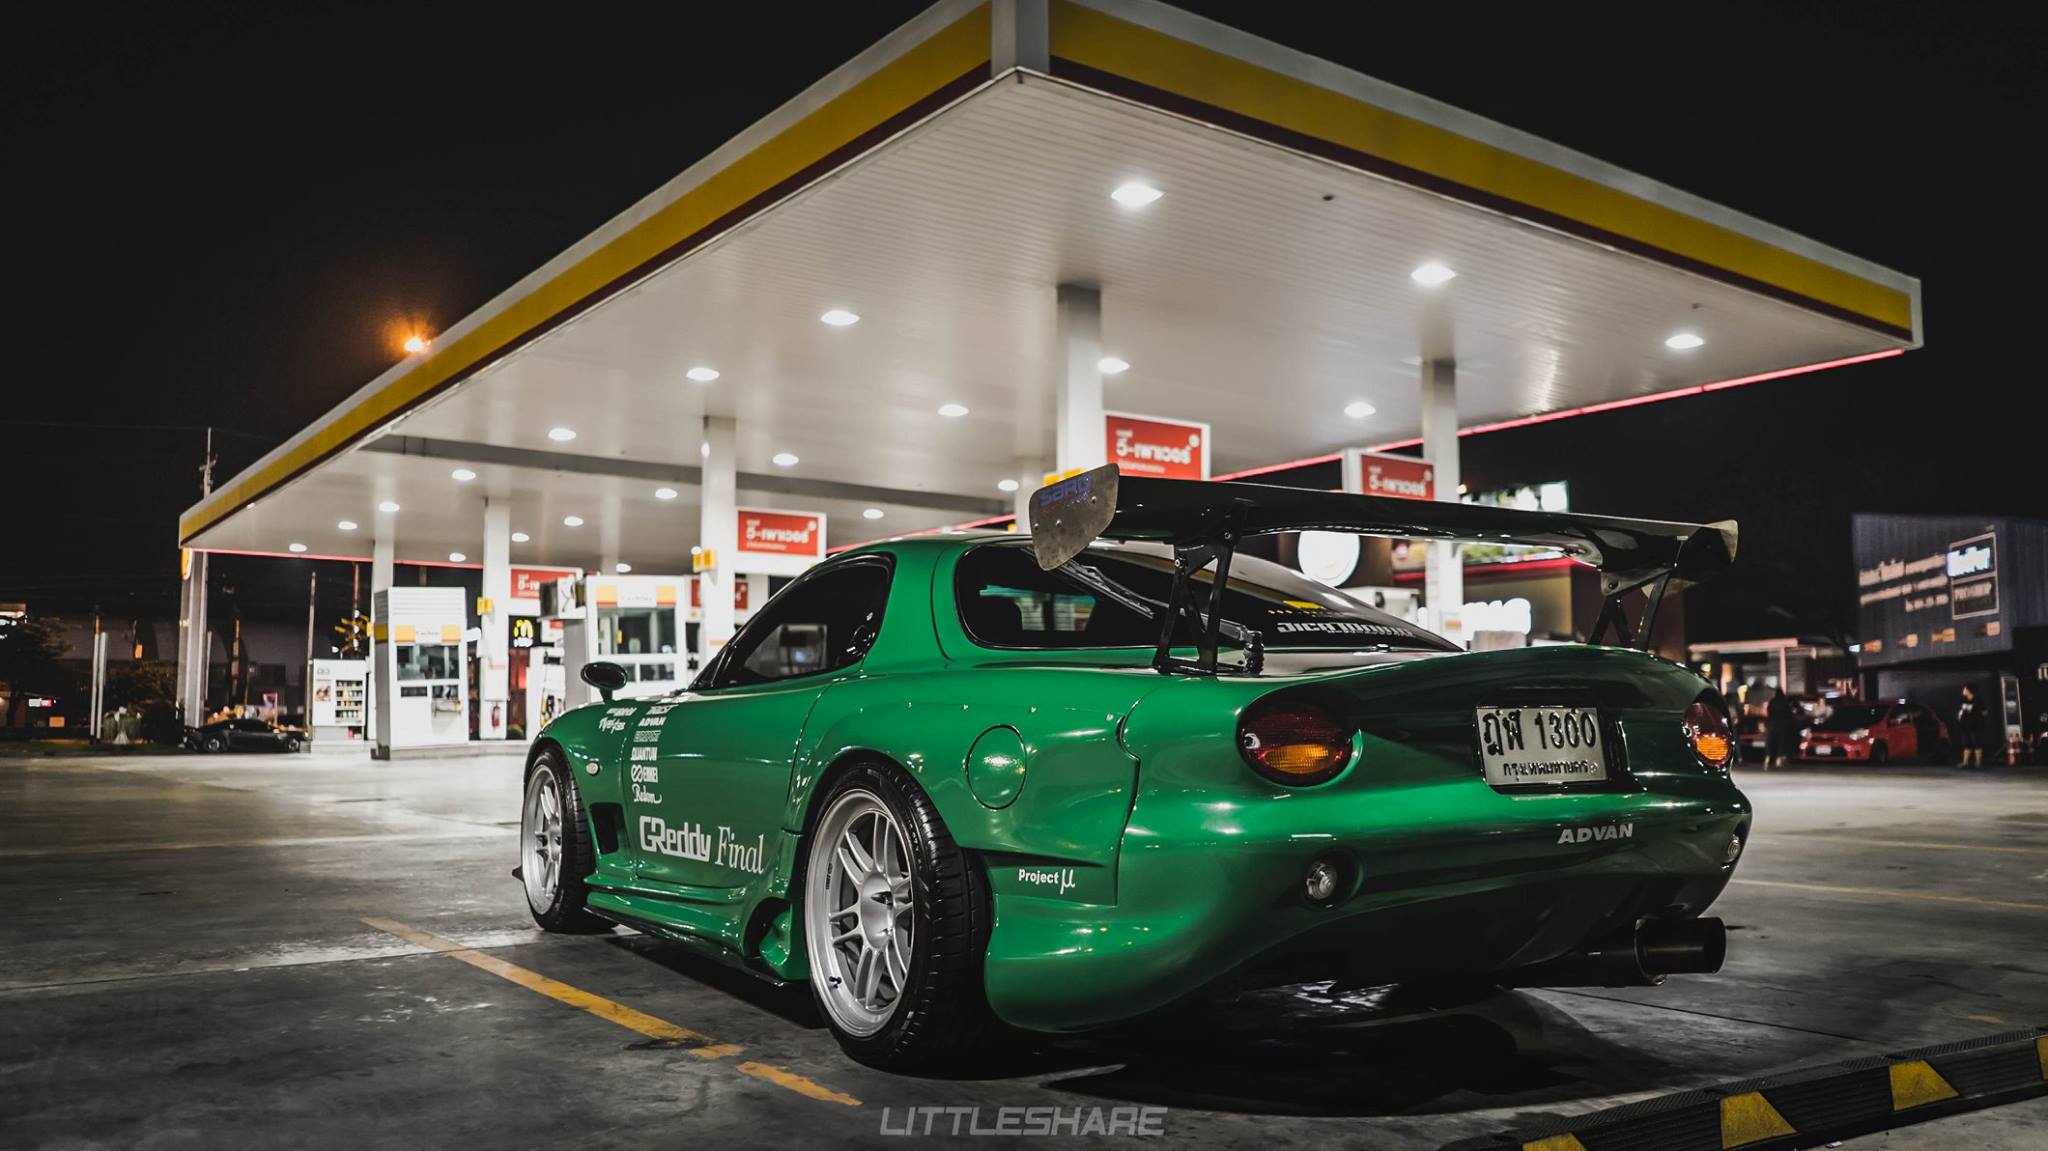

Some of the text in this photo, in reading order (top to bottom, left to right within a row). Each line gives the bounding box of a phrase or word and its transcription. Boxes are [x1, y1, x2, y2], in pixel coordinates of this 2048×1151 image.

[1534, 711, 1596, 749] 1300
[1503, 760, 1589, 781] กรุงเทพมหานคร
[1557, 823, 1633, 844] ADVAN
[639, 815, 764, 874] GReddy Final
[1018, 868, 1059, 885] Project
